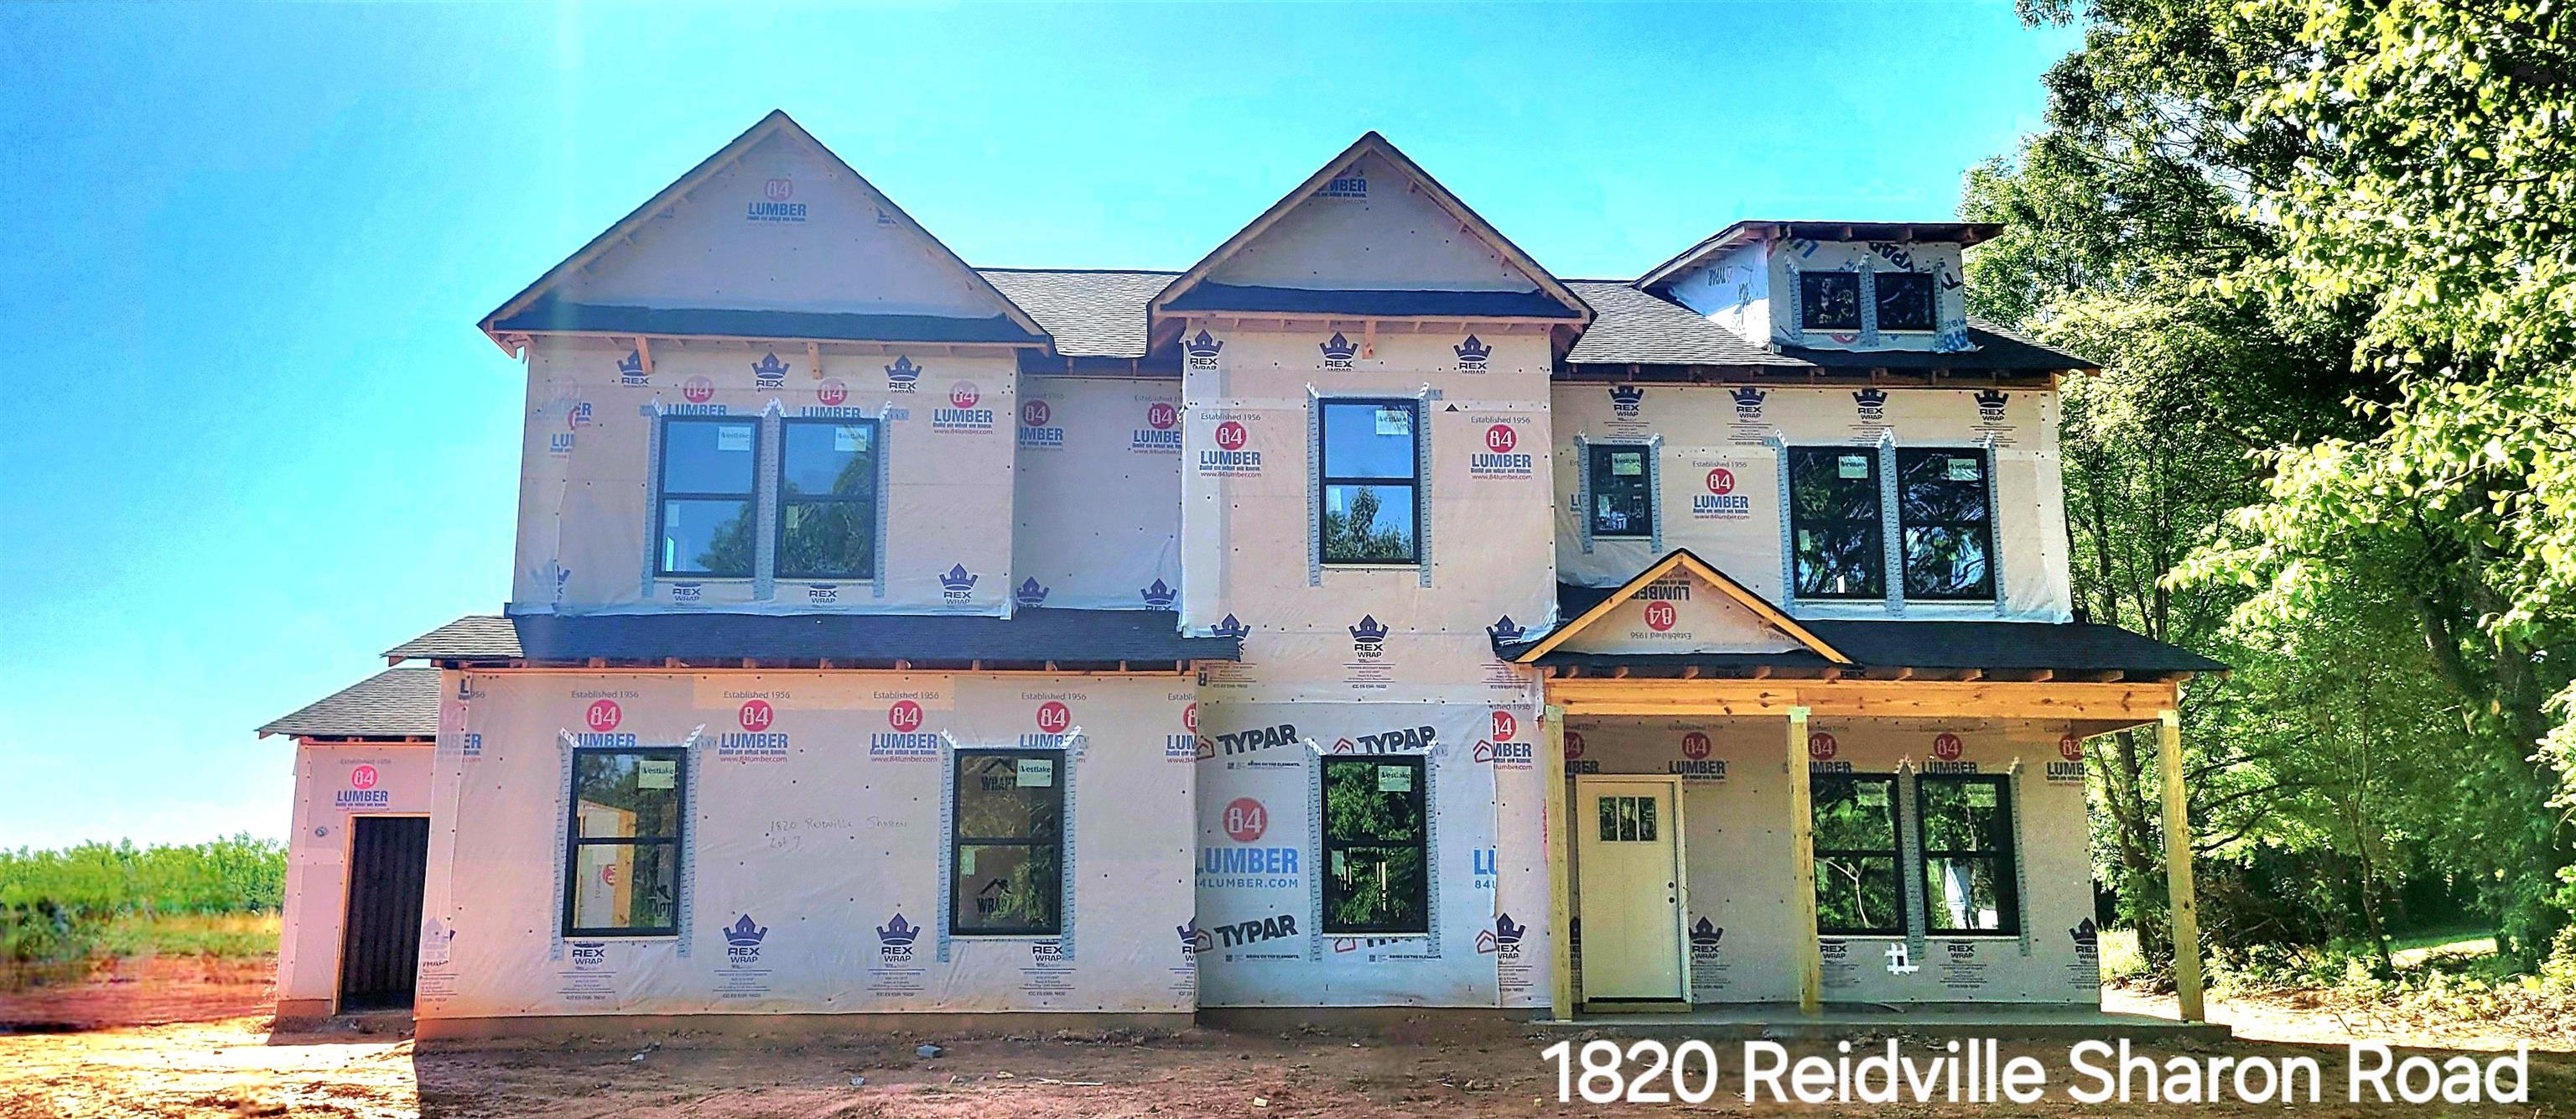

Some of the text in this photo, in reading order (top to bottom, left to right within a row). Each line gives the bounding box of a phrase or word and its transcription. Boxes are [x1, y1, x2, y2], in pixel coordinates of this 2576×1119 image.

[748, 202, 807, 216] LUMBER
[1324, 360, 1353, 368] REX
[889, 382, 917, 390] REX
[934, 409, 993, 423] LUMBER
[1150, 409, 1173, 425] 84
[1201, 413, 1242, 421] Established
[1219, 427, 1243, 445] 84
[1489, 430, 1513, 447] 84
[1200, 450, 1261, 466] LUMBER
[1472, 454, 1532, 468] LUMBER
[1709, 473, 1732, 490] 84
[1694, 496, 1748, 508] LUMBER
[1648, 607, 1673, 625] 84
[1630, 631, 1692, 641] Established 1956
[571, 690, 639, 700] Established 1956
[724, 690, 790, 700] Established 1956
[873, 691, 939, 700] Established 1956
[1021, 692, 1066, 700] Established
[589, 706, 617, 726] 84
[742, 707, 768, 726] 84
[892, 707, 918, 726] 84
[1040, 709, 1066, 727] 84
[720, 733, 788, 749] LUMBER
[870, 733, 937, 749] LUMBER
[1216, 724, 1300, 756] TYPAR
[1685, 737, 1707, 754] 84
[1811, 738, 1833, 755] 84
[1937, 739, 1960, 755] 84
[1669, 760, 1726, 774] LUMBER
[1921, 762, 1977, 774] LUMBER
[354, 770, 375, 785] 84
[337, 790, 388, 803] LUMBER
[1228, 807, 1262, 834] 84
[1214, 914, 1299, 948] TYPAR
[572, 949, 605, 957] REX
[728, 947, 760, 955] REX
[881, 946, 913, 955] REX
[1032, 946, 1063, 955] REX
[1948, 945, 1975, 953] REX
